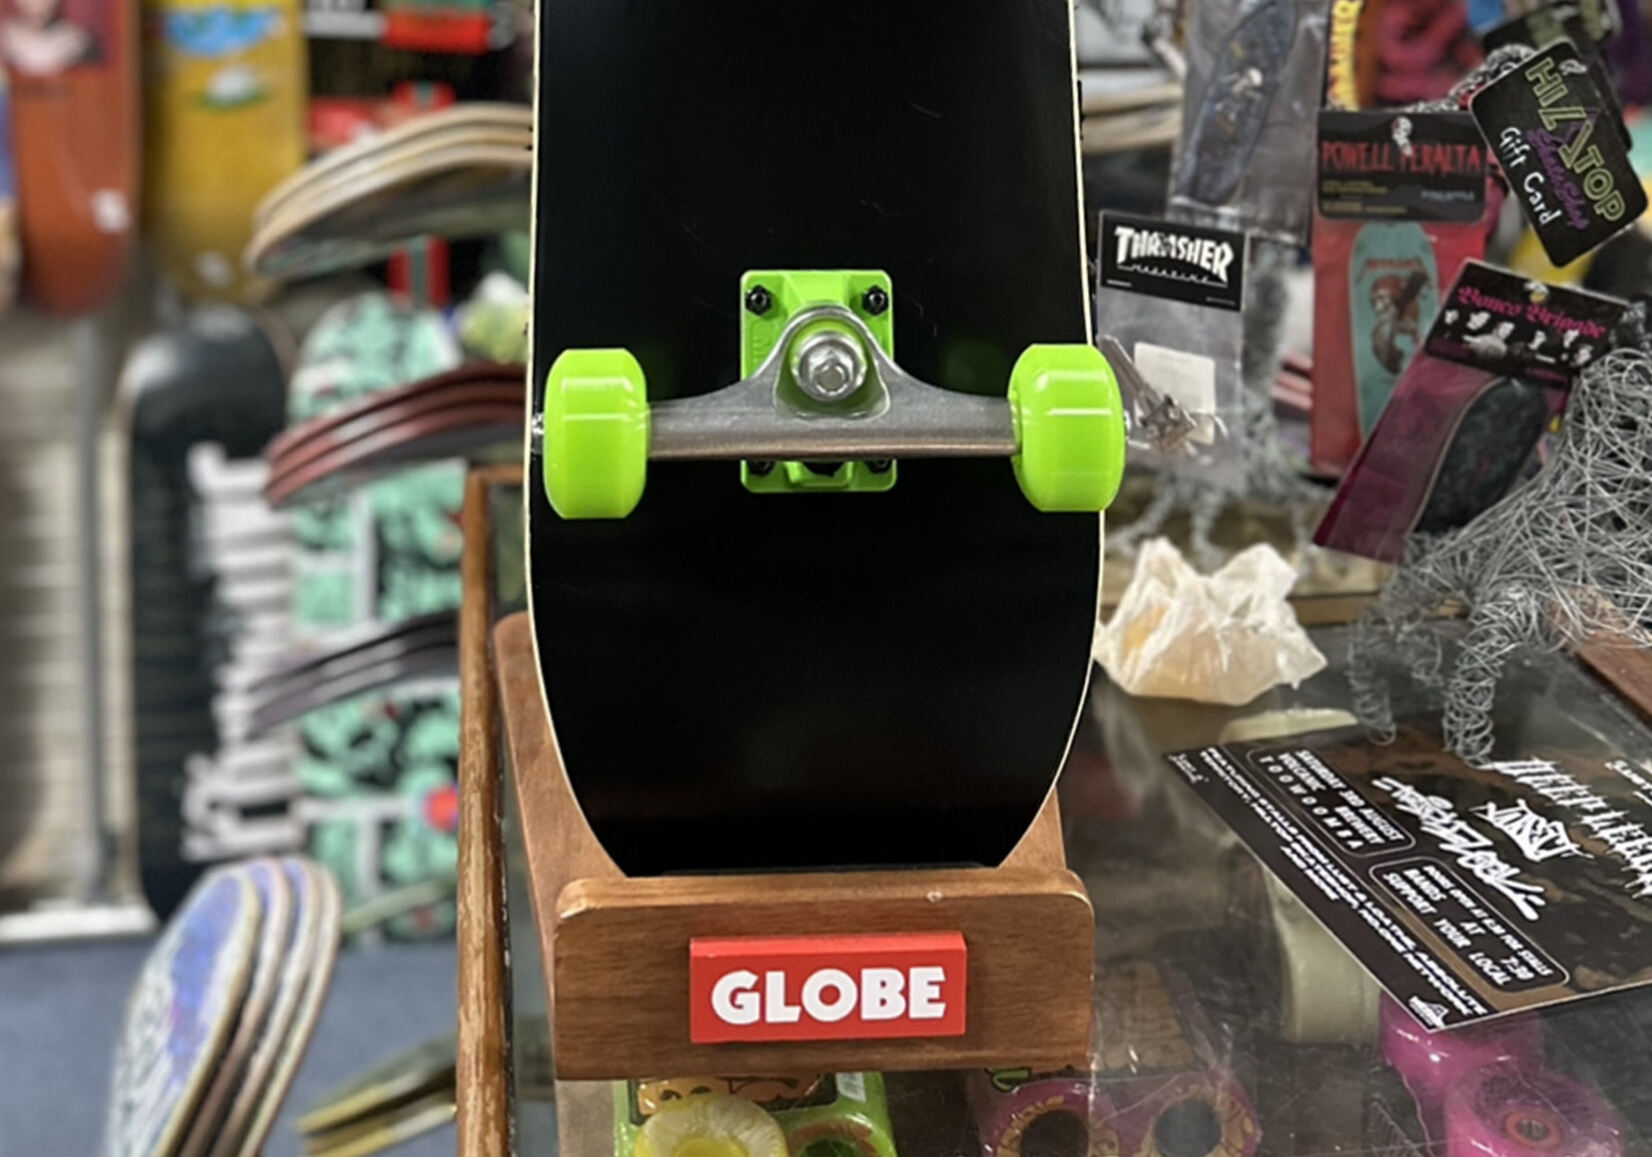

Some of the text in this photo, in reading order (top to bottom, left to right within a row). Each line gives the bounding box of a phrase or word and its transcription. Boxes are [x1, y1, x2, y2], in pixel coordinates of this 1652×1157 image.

[1321, 141, 1481, 176] POWELL PERALTA
[1500, 127, 1563, 226] Gift Card
[1114, 226, 1235, 283] THRASHER
[1458, 285, 1607, 339] Bones Brigade
[1259, 756, 1363, 849] TOOWOOMBA
[1278, 752, 1385, 843] VOLCANIC BREWERY
[1295, 750, 1405, 841] SATURDAY 3RD AUGUST
[1207, 747, 1261, 798] FEATURING
[1258, 797, 1299, 835] STALLS
[1296, 835, 1329, 864] FROM
[1415, 951, 1489, 1015] ABSOLUTE
[1280, 845, 1340, 901] AND MORE
[1403, 868, 1447, 901] BANDS
[1460, 922, 1486, 935] AT
[1382, 872, 1511, 985] SUPPORT YOUR LOCAL
[1471, 908, 1489, 919] AT
[1517, 950, 1553, 976] STALLS
[711, 966, 946, 1025] GLOBE
[1403, 953, 1473, 1016] NETWORK
